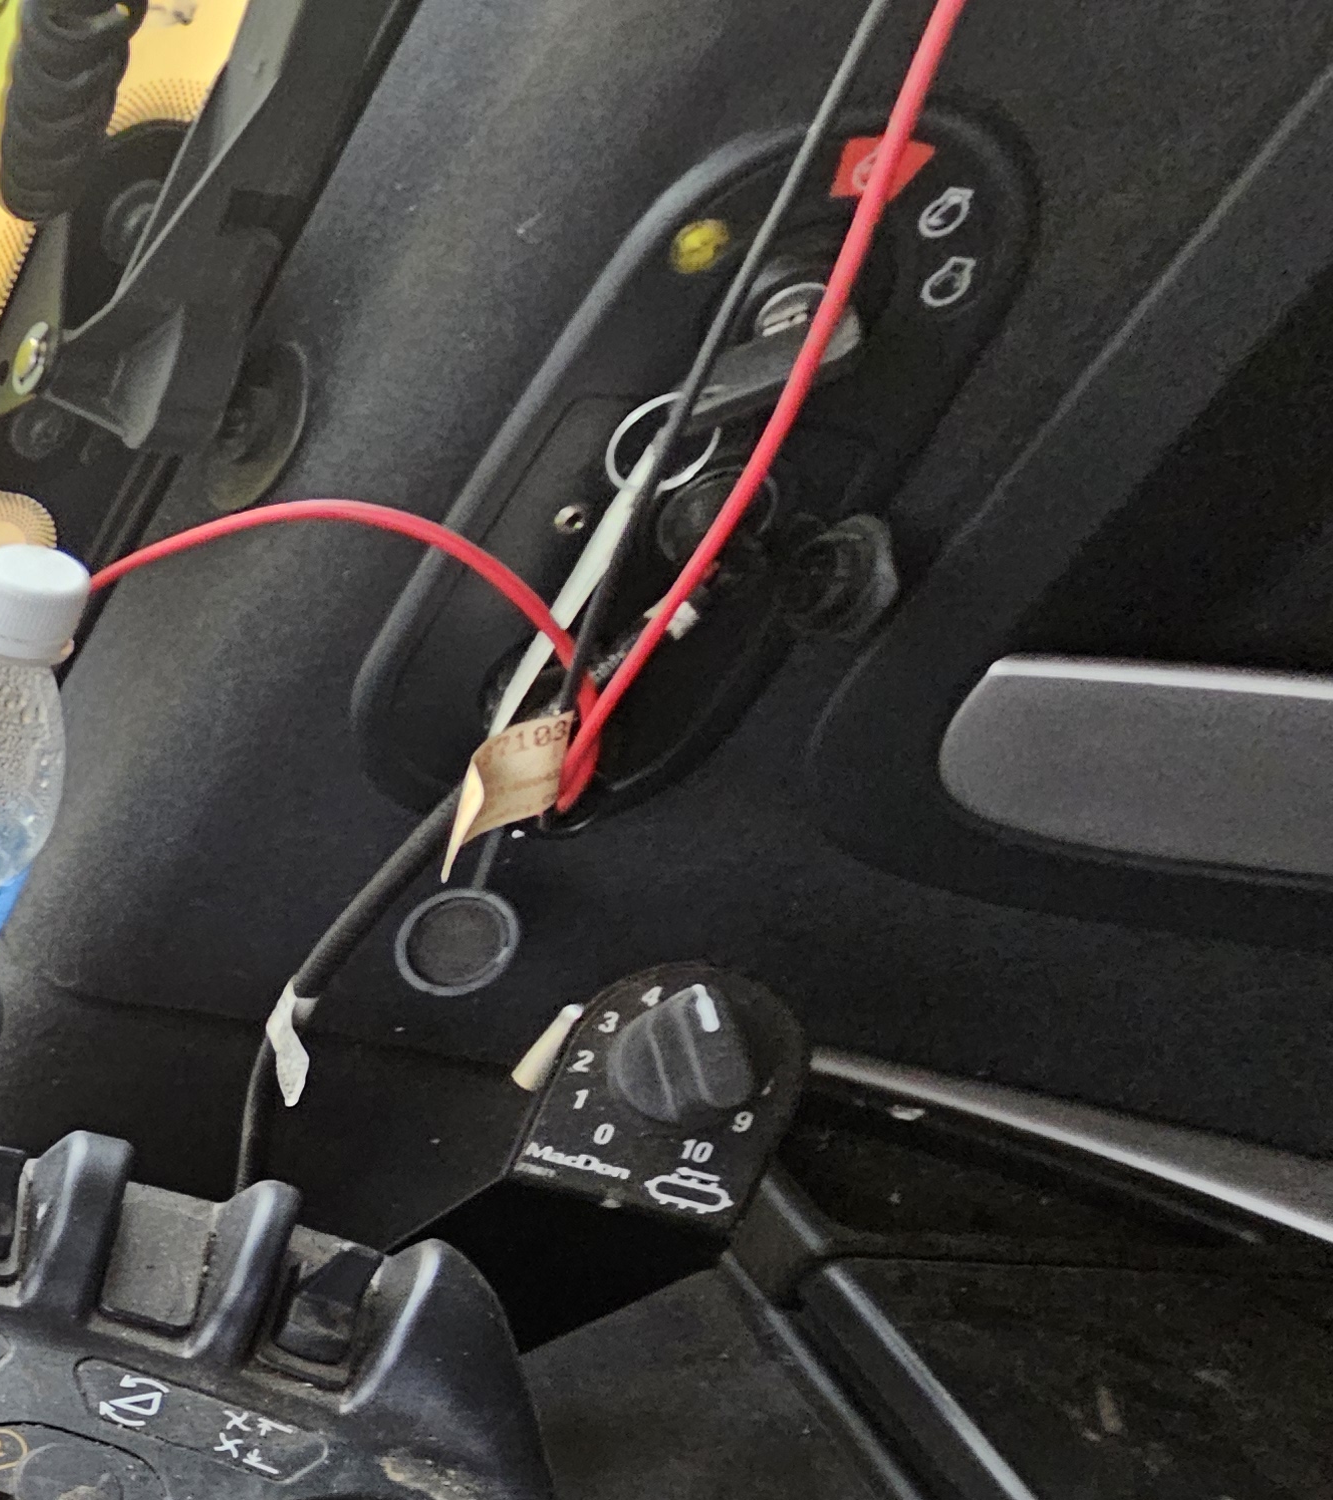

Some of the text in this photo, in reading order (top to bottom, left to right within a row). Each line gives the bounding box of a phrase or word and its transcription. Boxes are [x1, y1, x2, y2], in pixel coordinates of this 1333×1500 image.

[641, 986, 663, 1007] 4
[598, 1011, 620, 1033] 3
[568, 1050, 595, 1073] 2
[572, 1089, 589, 1110] 1
[731, 1111, 754, 1133] 9
[593, 1123, 615, 1145] 0
[524, 1141, 631, 1180] MacDon
[681, 1139, 714, 1163] 10
